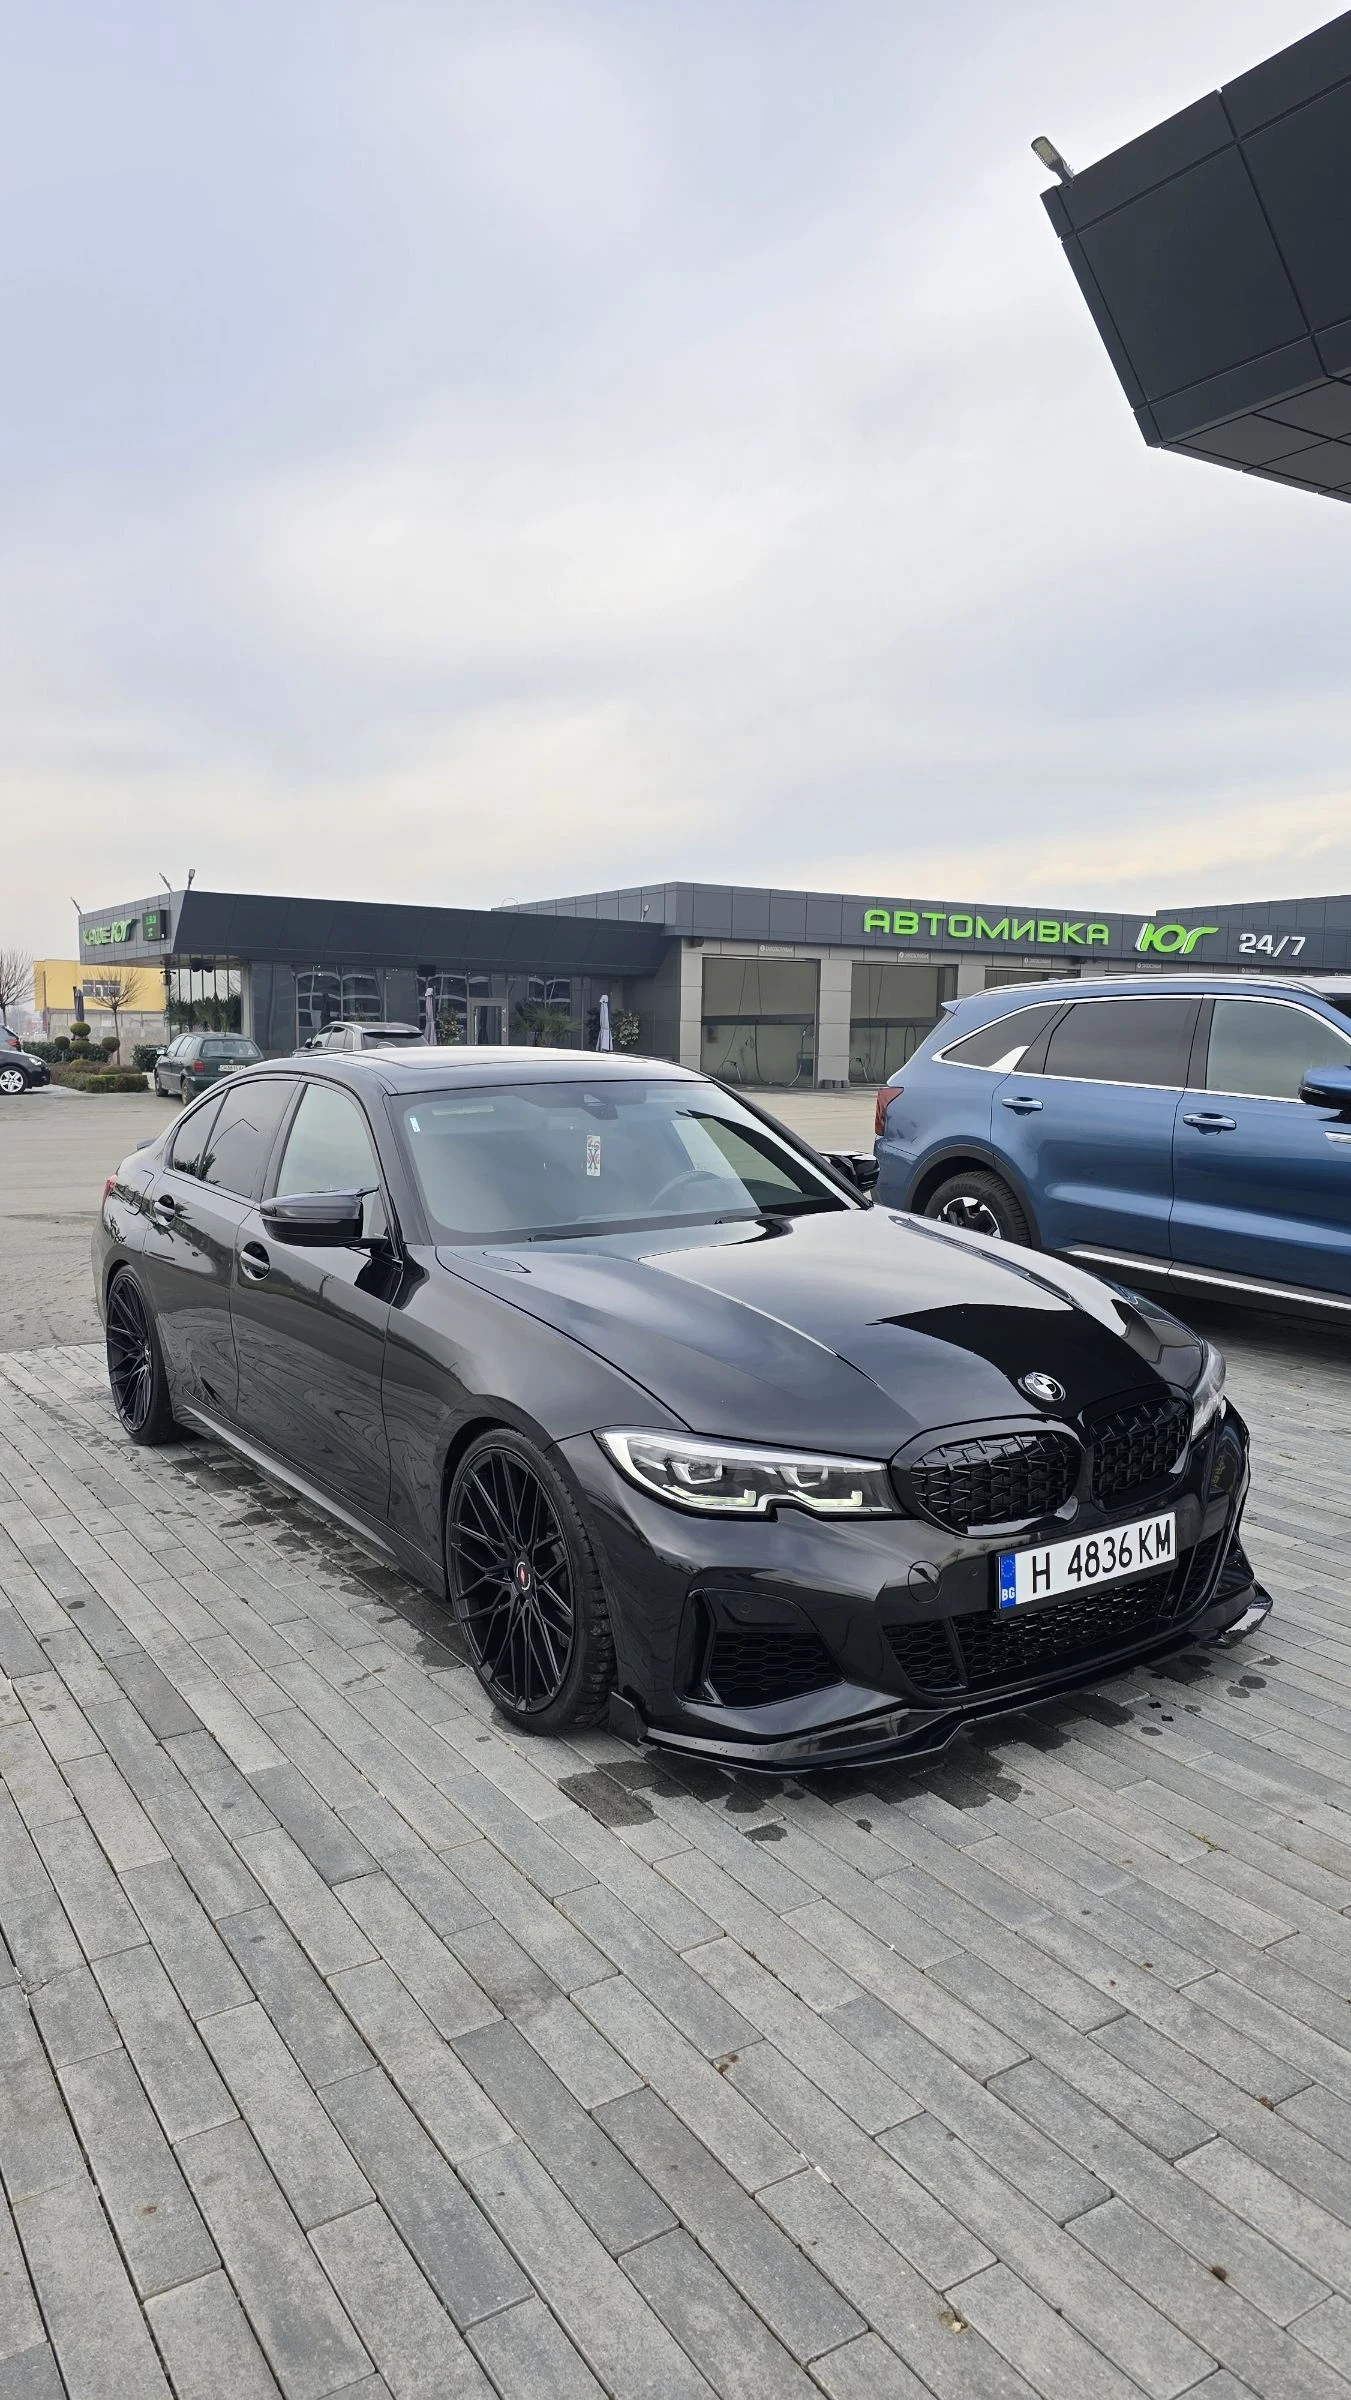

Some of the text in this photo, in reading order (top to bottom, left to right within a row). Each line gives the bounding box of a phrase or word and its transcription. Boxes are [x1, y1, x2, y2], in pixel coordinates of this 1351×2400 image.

[863, 909, 1109, 945] АВТОМИВКА
[1238, 933, 1306, 958] 24/7
[1032, 1519, 1170, 1594] H 4836 KM
[1001, 1586, 1016, 1601] BG
